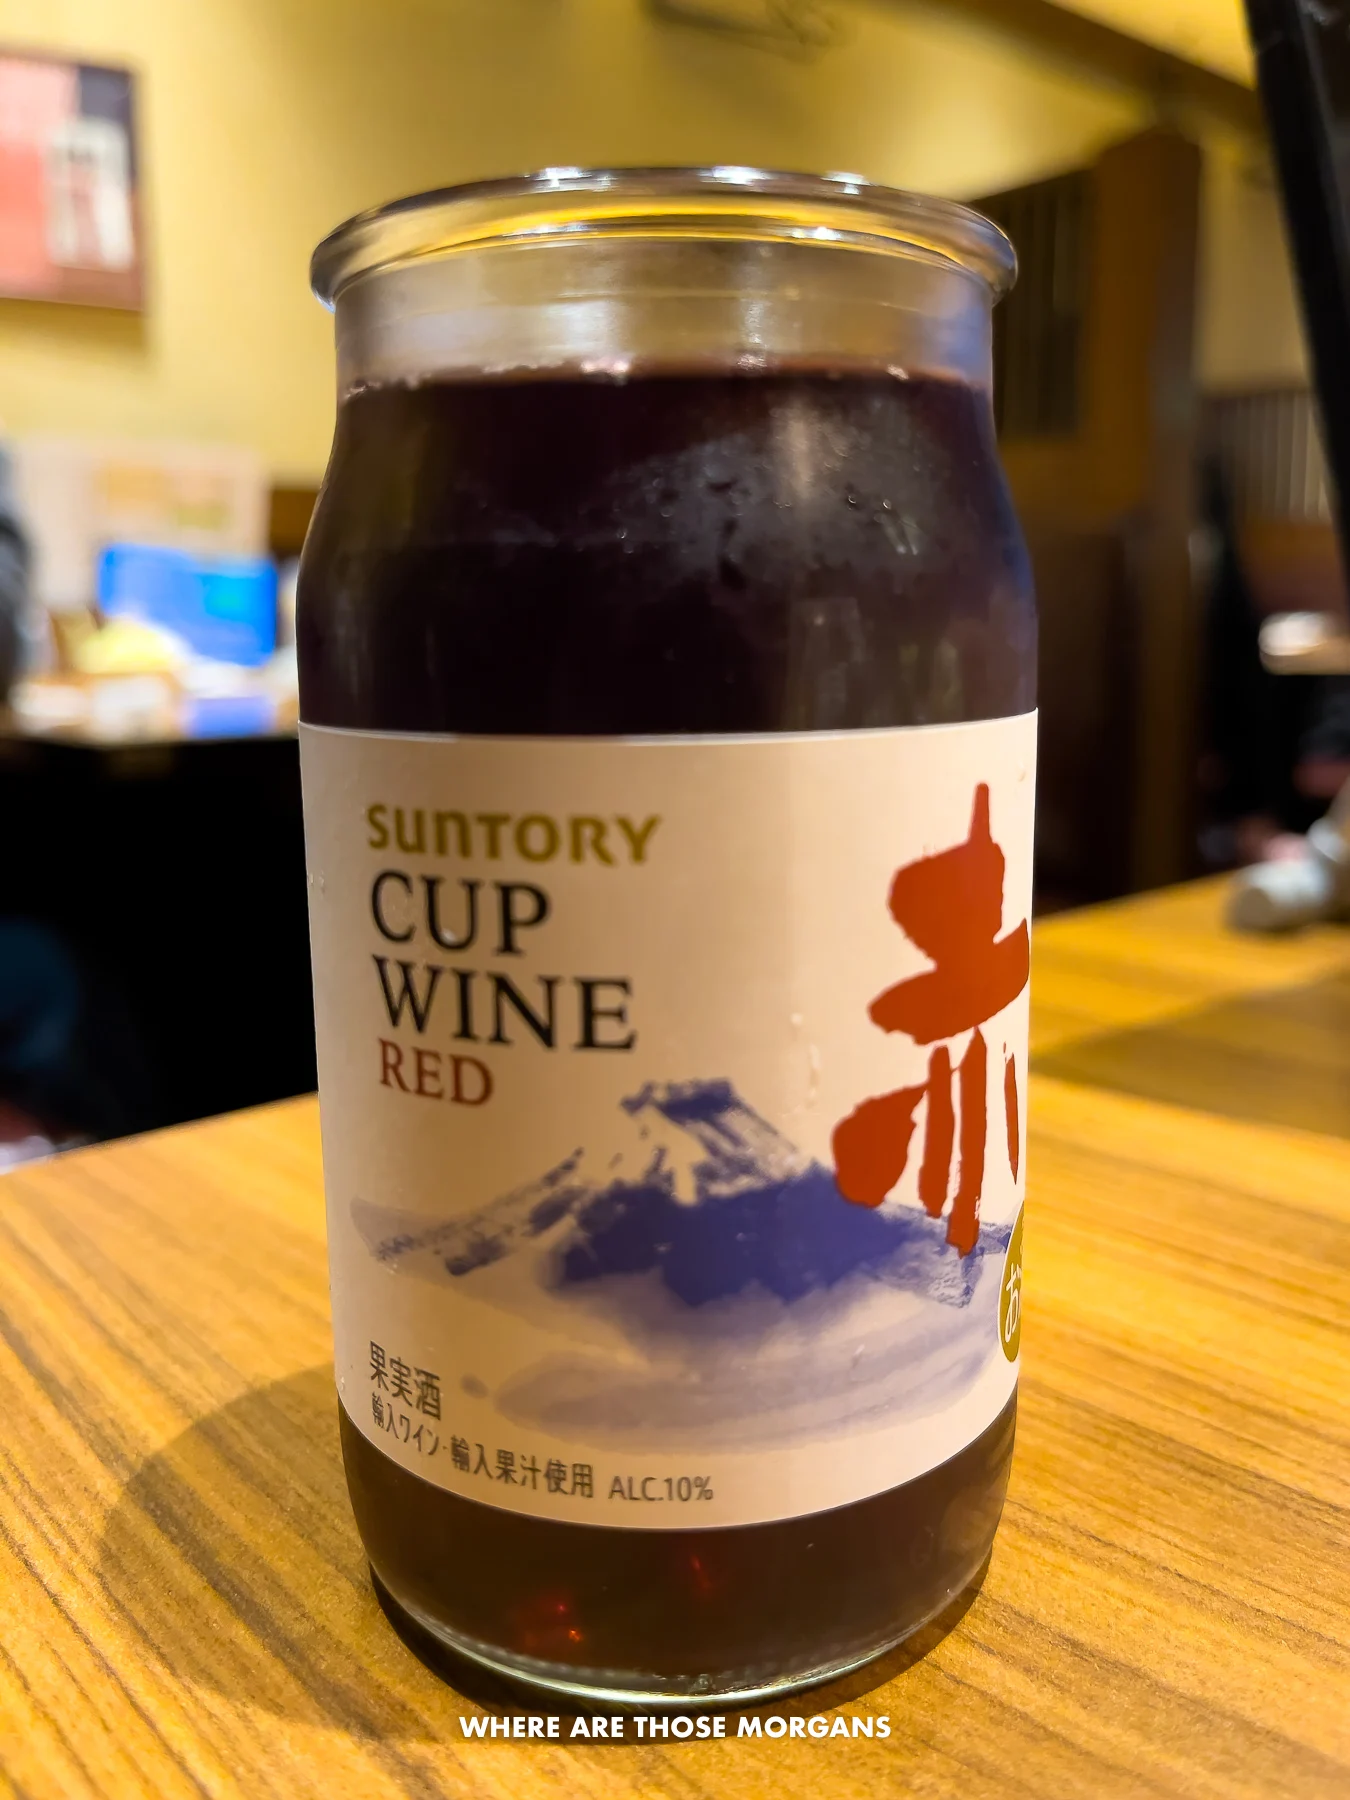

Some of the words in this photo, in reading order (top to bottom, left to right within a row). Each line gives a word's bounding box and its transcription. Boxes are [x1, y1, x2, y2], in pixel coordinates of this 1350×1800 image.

[371, 869, 553, 957] CUP
[371, 955, 638, 1053] WINE
[831, 781, 1030, 1260] 赤
[377, 1036, 495, 1107] RED
[369, 1340, 442, 1422] 果実酒
